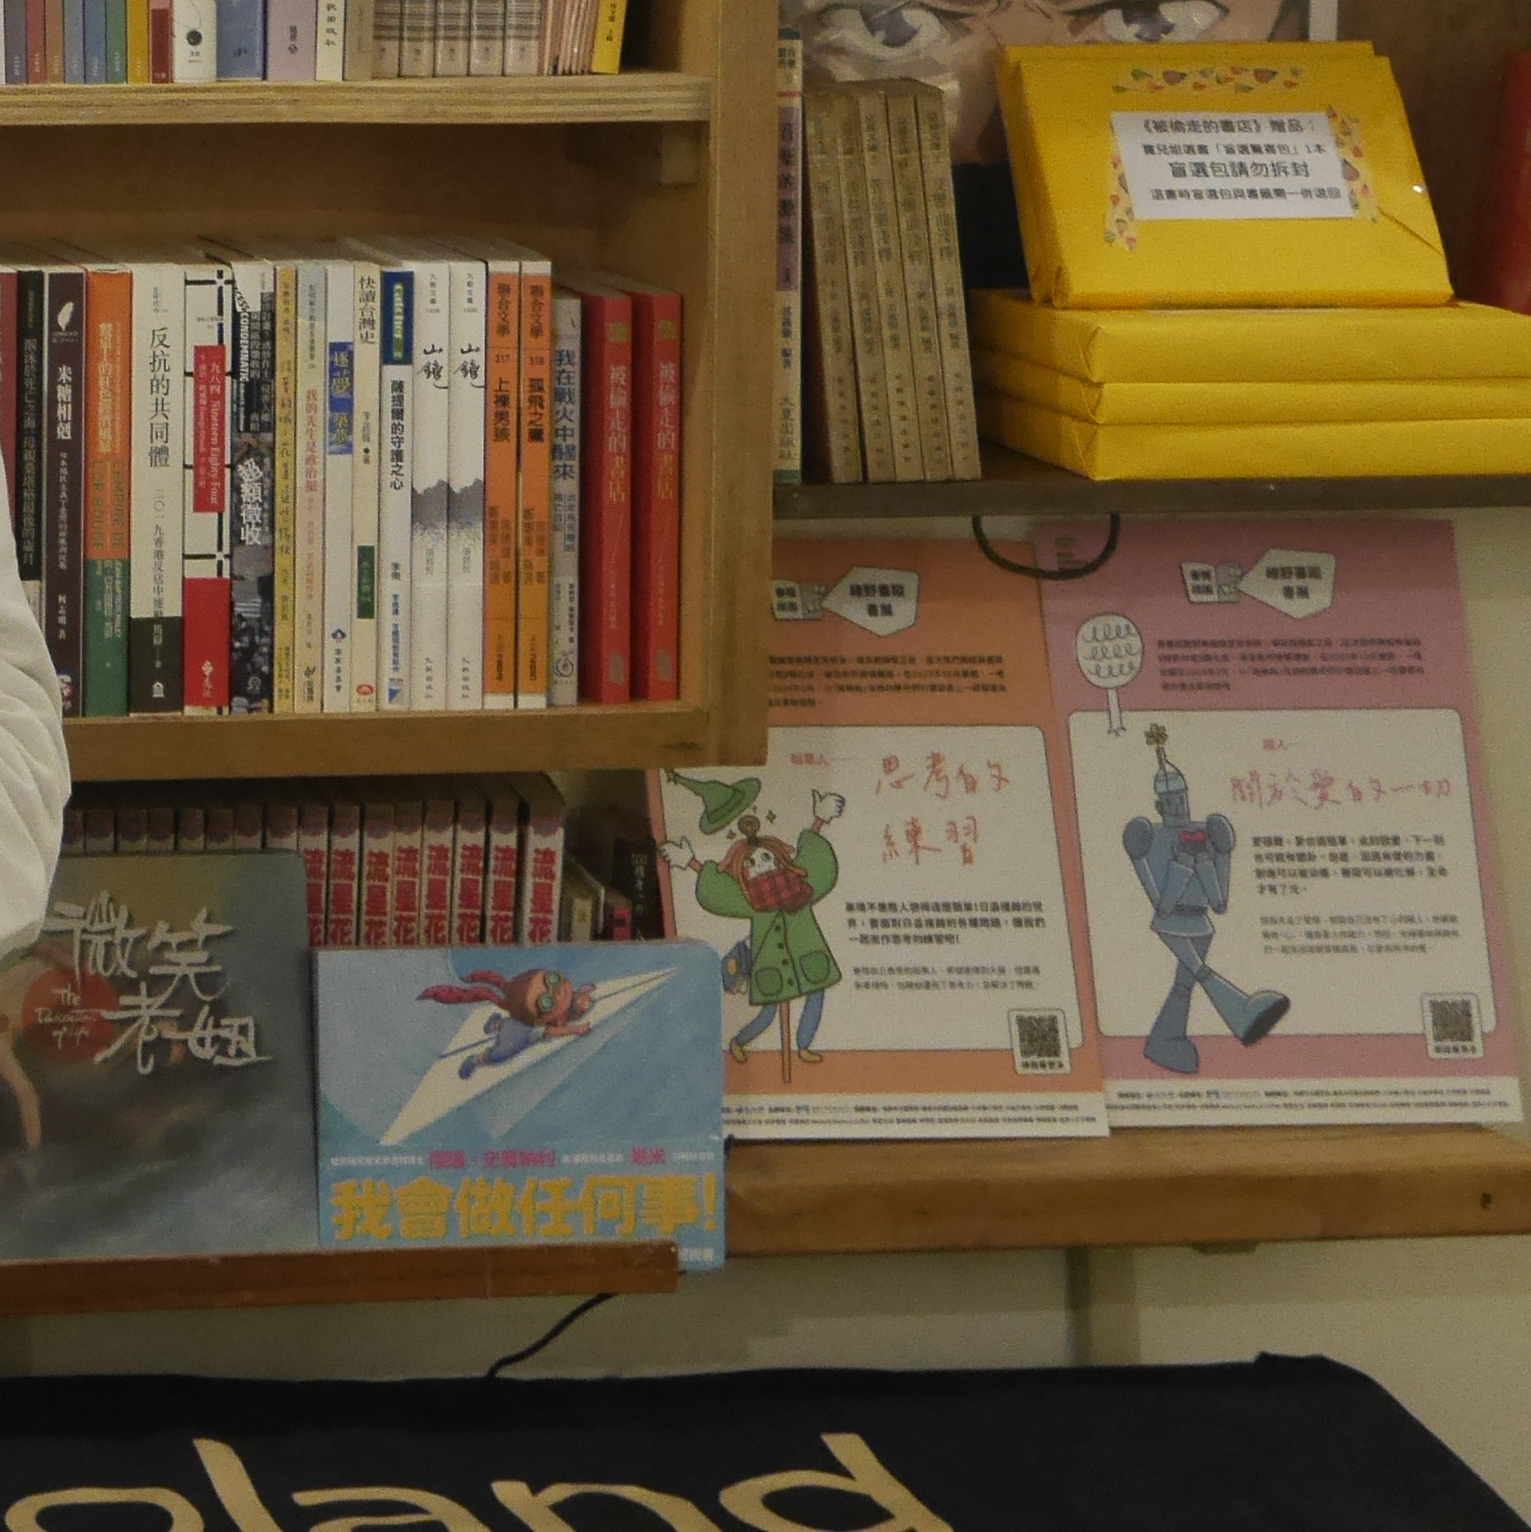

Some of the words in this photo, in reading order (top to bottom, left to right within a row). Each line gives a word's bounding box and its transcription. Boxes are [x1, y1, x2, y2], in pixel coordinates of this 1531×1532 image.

[1143, 119, 1263, 134] 《被偷走的書店》
[1169, 161, 1310, 179] 盲選包請勿拆封
[358, 275, 377, 345] 快讀台灣史
[148, 326, 171, 468] 反抗的共同體
[390, 379, 405, 491] 薩提爾的守護之心
[554, 349, 576, 481] 我在戰火中醒來
[607, 363, 628, 504] 被偷走的書店
[656, 361, 677, 505] 被偷走的書店
[330, 1174, 716, 1241] 我會做任何事!
